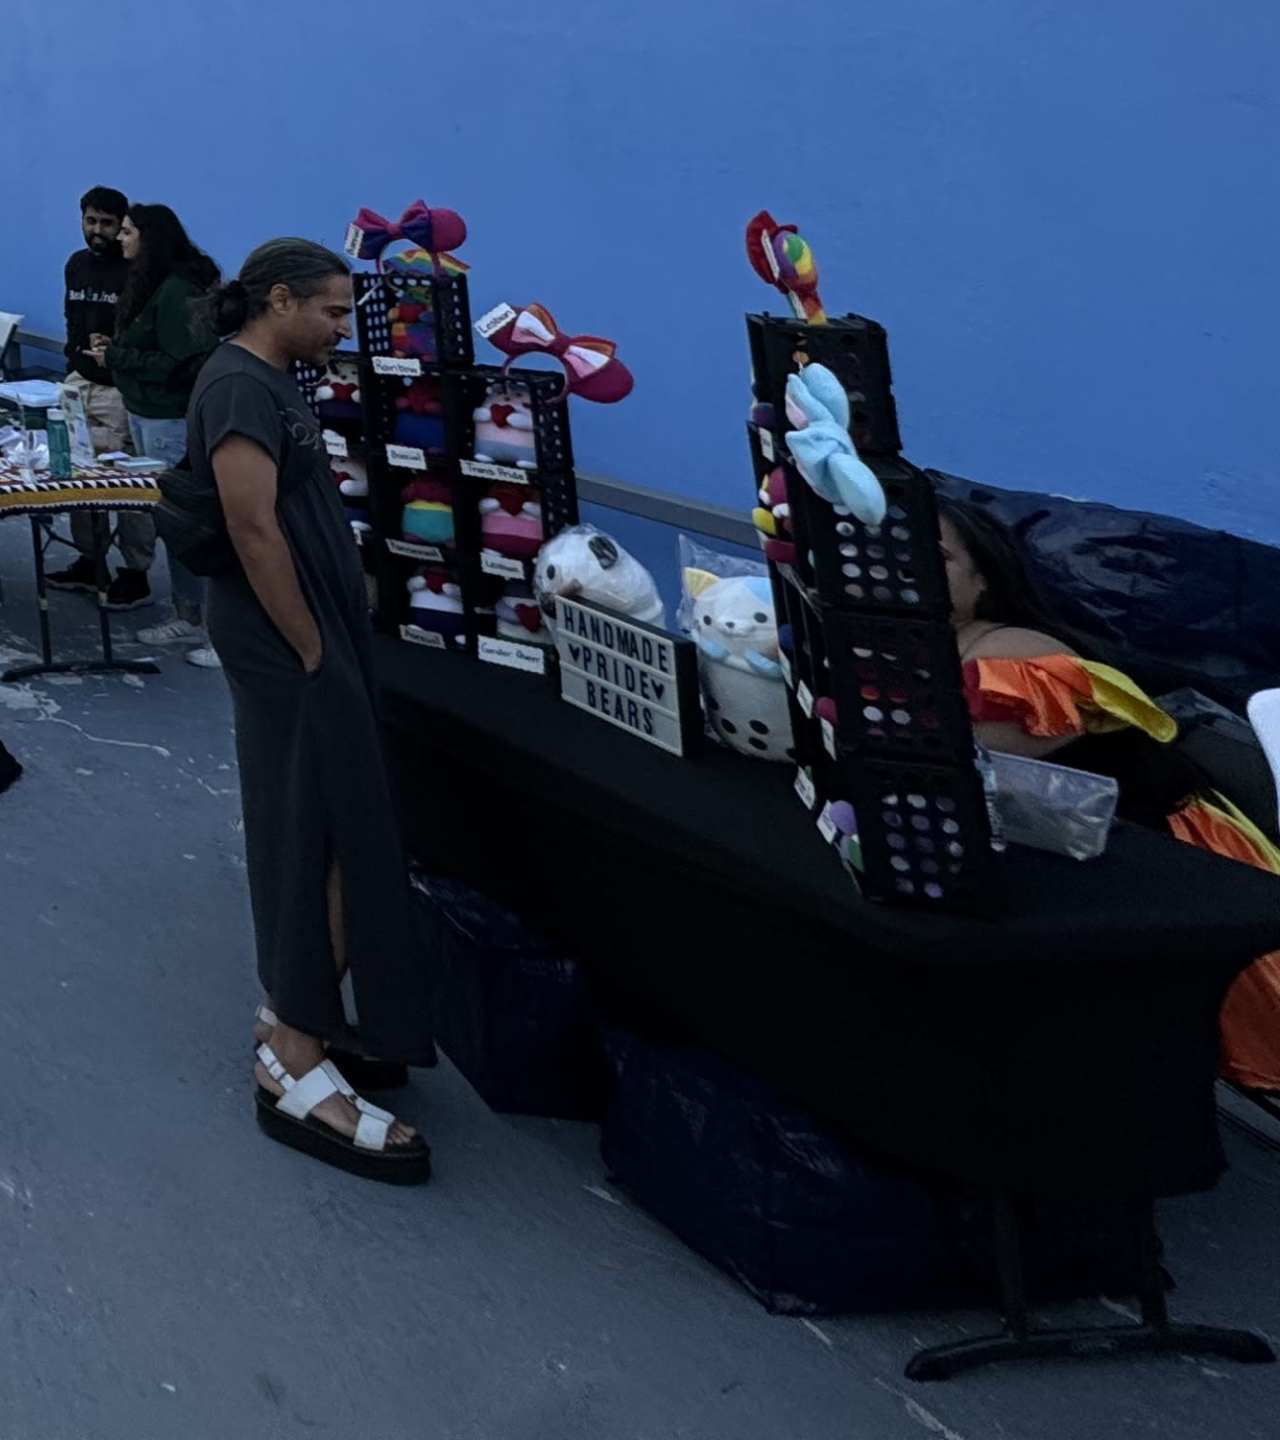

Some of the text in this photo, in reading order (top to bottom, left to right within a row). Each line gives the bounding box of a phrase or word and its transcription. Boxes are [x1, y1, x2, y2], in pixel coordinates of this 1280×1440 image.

[563, 604, 669, 673] HANDMADE
[582, 649, 650, 701] PRIDE
[586, 679, 654, 736] BEARS
